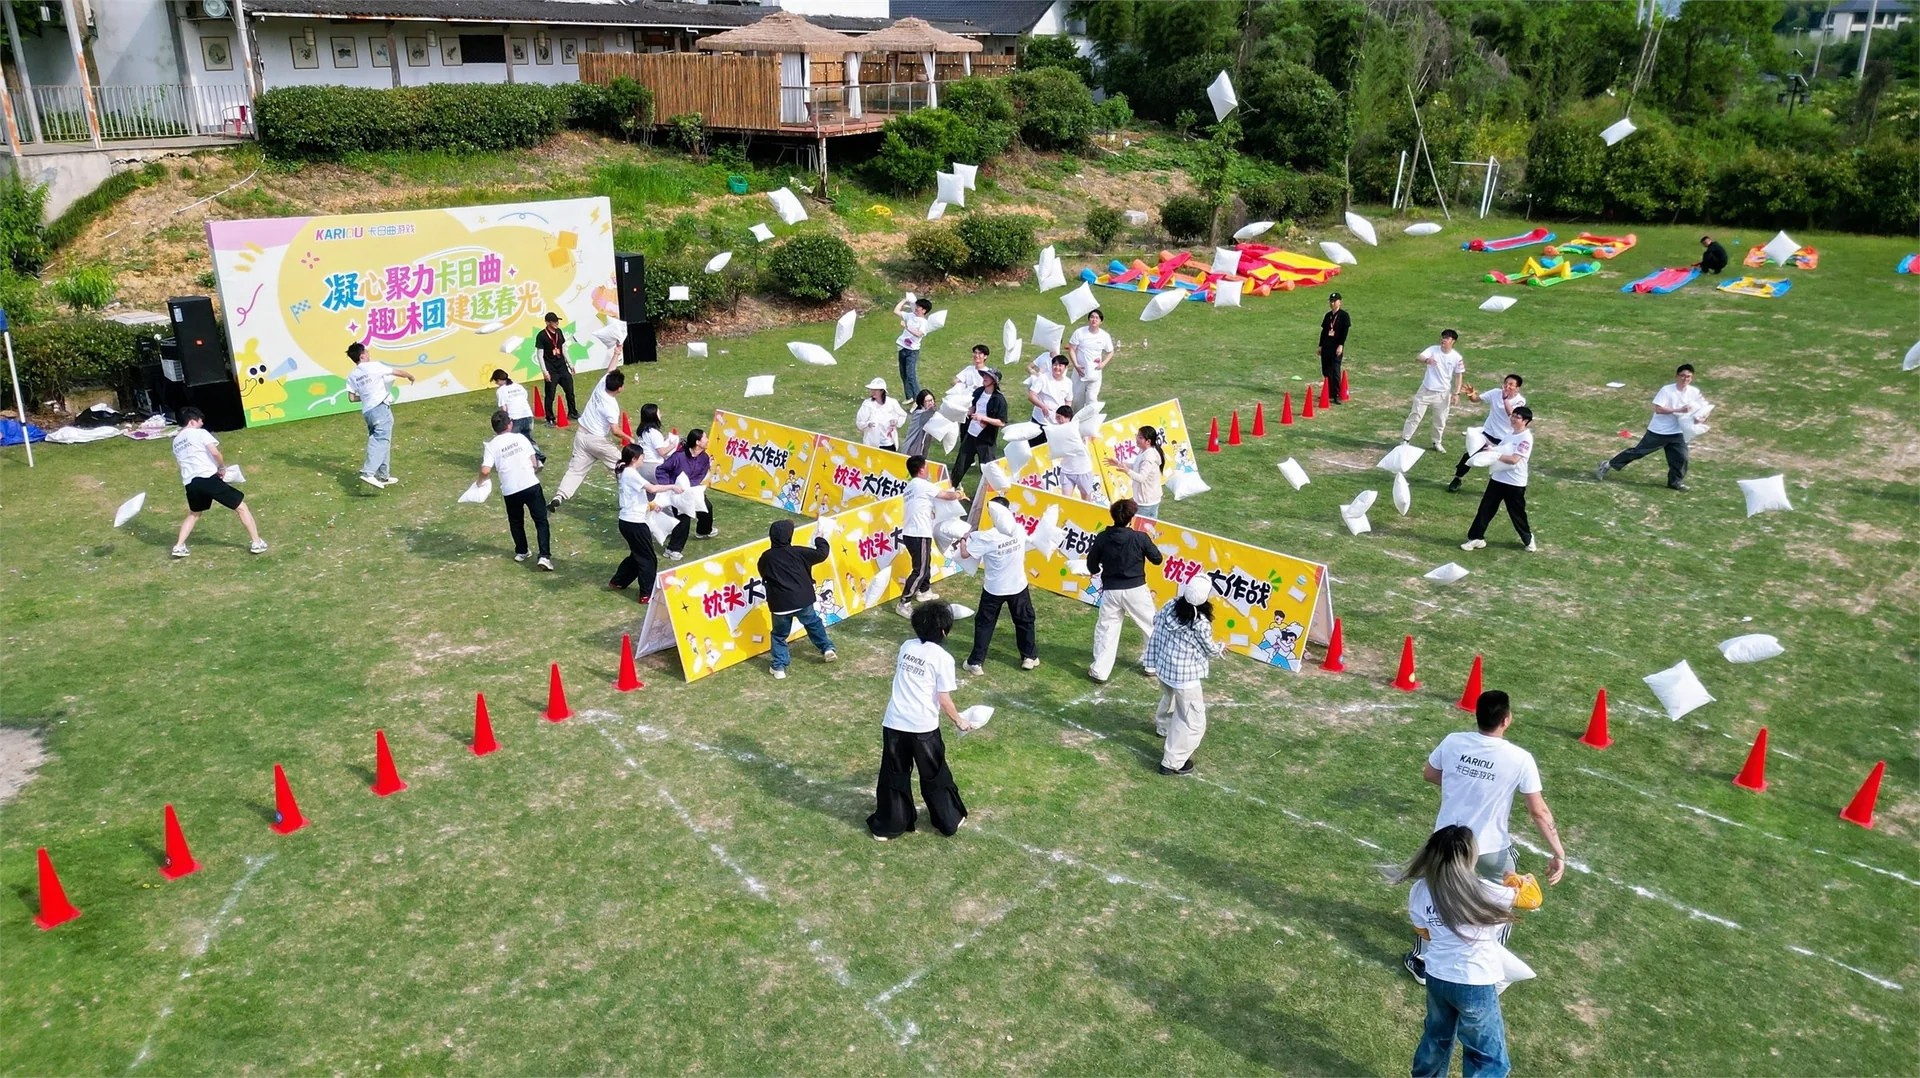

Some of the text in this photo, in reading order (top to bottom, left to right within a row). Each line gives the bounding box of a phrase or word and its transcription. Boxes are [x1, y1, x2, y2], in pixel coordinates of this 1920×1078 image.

[368, 223, 416, 237] 卡日曲游戏
[321, 253, 502, 311] 凝心聚力卡日曲
[360, 281, 543, 347] 趣味团建逐春光
[725, 437, 789, 470] 枕头大作战
[858, 526, 904, 561] 枕头大
[702, 577, 766, 619] 枕头大
[1455, 764, 1496, 781] 卡日曲游戏
